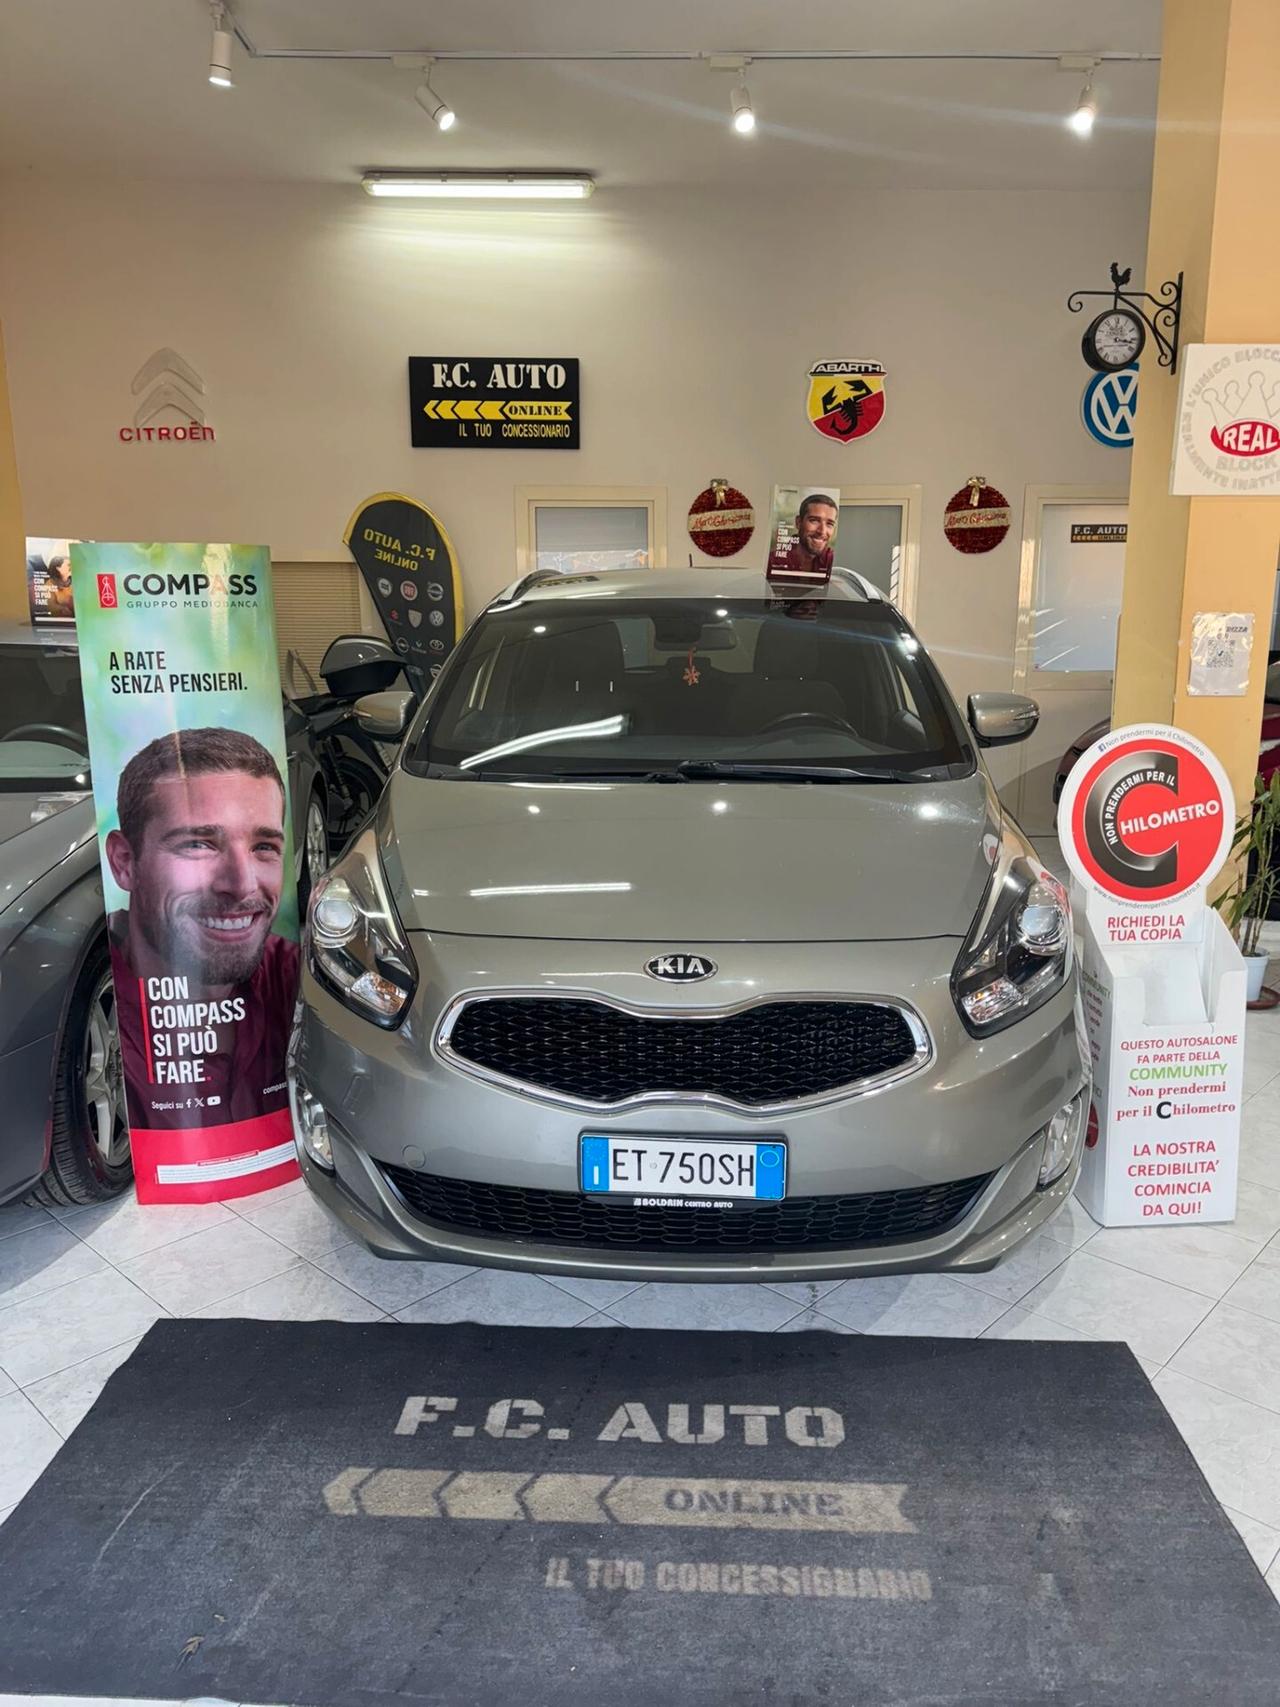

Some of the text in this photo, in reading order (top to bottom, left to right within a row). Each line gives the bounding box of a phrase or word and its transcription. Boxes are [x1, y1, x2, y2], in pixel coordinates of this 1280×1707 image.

[432, 363, 566, 389] F.C. AUTO
[816, 363, 880, 372] ABARTH
[509, 406, 562, 416] ONLINE
[459, 424, 570, 438] IL TUO CONCESSIONARIO
[1222, 424, 1278, 452] REAL
[1216, 456, 1278, 472] BLOCK
[124, 573, 258, 595] COMPASS
[110, 651, 166, 670] A RATE
[111, 672, 248, 694] SENZA PENSIERI.
[1105, 771, 1175, 845] NON PRENDERMI PER IL
[1108, 915, 1185, 928] RICHIEDI LA
[1109, 928, 1181, 941] TUA COPIA
[658, 958, 705, 974] KIA
[148, 976, 188, 1001] CON
[150, 997, 246, 1029] COMPASS
[153, 1025, 218, 1057] SI PUÒ
[1120, 1035, 1238, 1051] QUESTO AUTOSALONE
[1137, 1051, 1220, 1064] FA PARTE DELLA
[1129, 1063, 1228, 1081] COMMUNITY
[1128, 1081, 1226, 1098] Non prendermi
[152, 1100, 174, 1111] Seguici
[1117, 1101, 1236, 1120] per il Chilometro
[1133, 1140, 1216, 1156] LA NOSTRA
[613, 1149, 647, 1181] ET
[659, 1151, 754, 1186] 750SH
[1134, 1182, 1211, 1196] COMINCIA
[643, 1198, 683, 1207] BOLDRIN
[1143, 1202, 1201, 1216] DA QUI!
[394, 1396, 845, 1448] F.C. AUTO
[663, 1487, 842, 1516] ONLINE
[546, 1558, 571, 1589] IL
[586, 1558, 644, 1591] TUO
